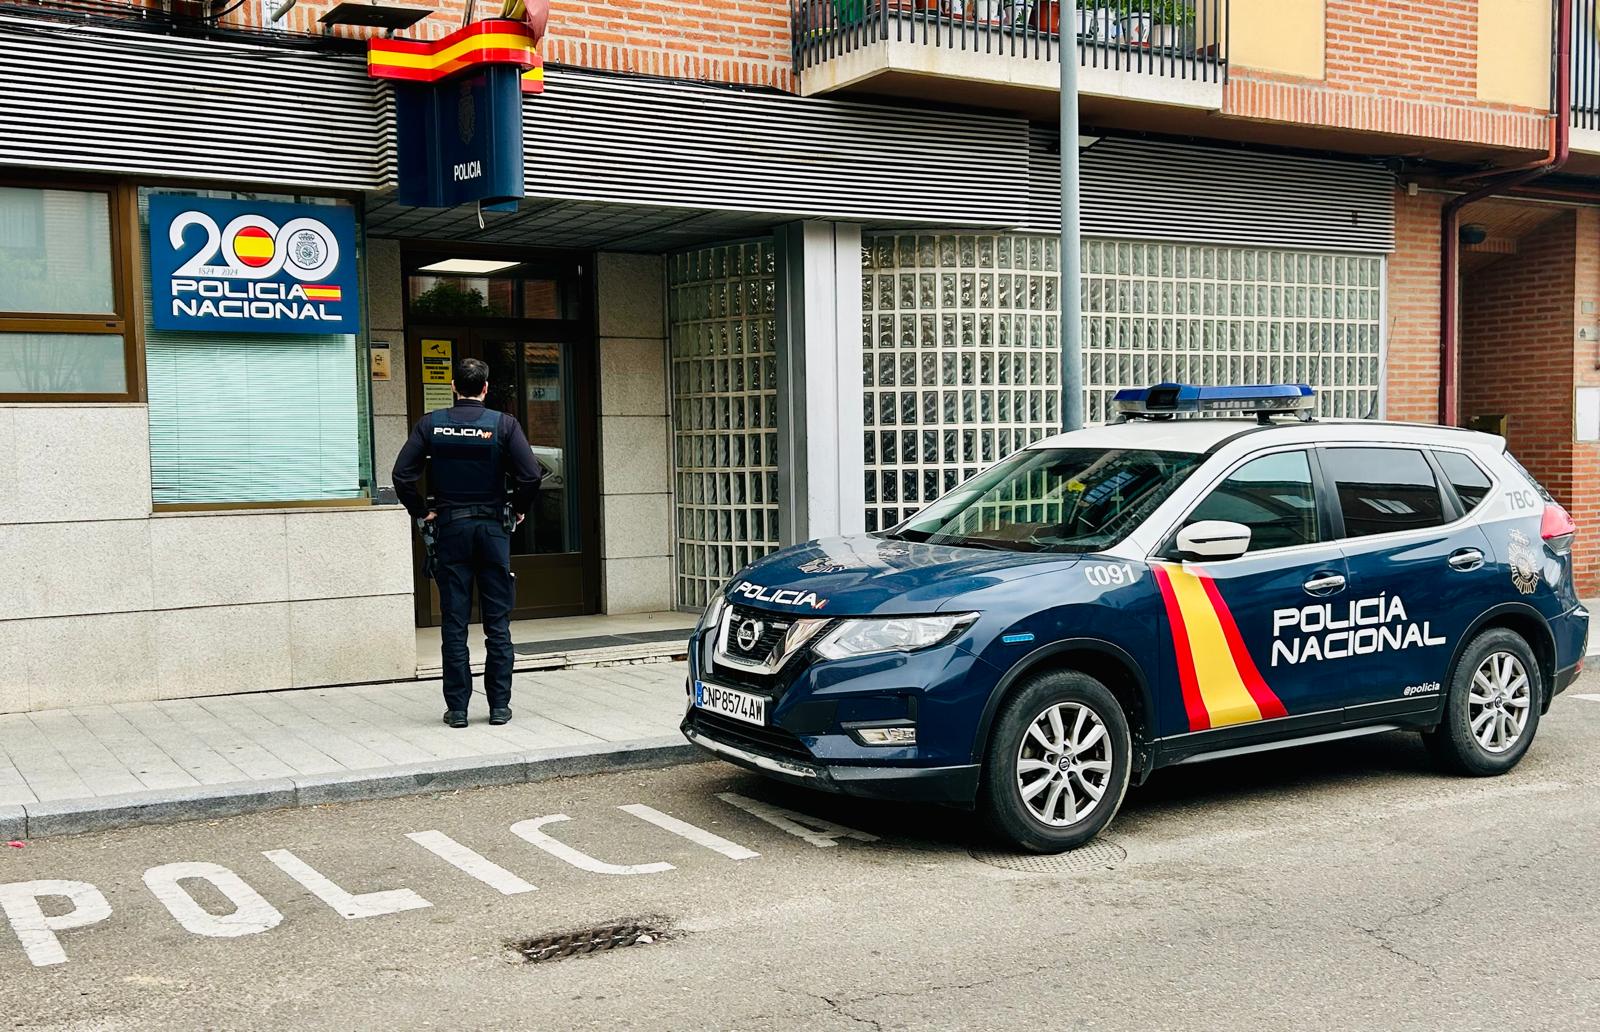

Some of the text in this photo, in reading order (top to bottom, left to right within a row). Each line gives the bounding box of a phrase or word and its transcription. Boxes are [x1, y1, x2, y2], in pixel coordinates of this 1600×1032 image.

[454, 160, 482, 181] POLICIA
[169, 211, 340, 281] 200
[172, 298, 343, 321] NACIONAL
[1505, 490, 1535, 511] 7BC
[1273, 591, 1408, 637] POLICÍA
[1271, 621, 1447, 667] NACIONAL
[1403, 681, 1441, 696] @policia
[0, 792, 881, 967] POLICIA
